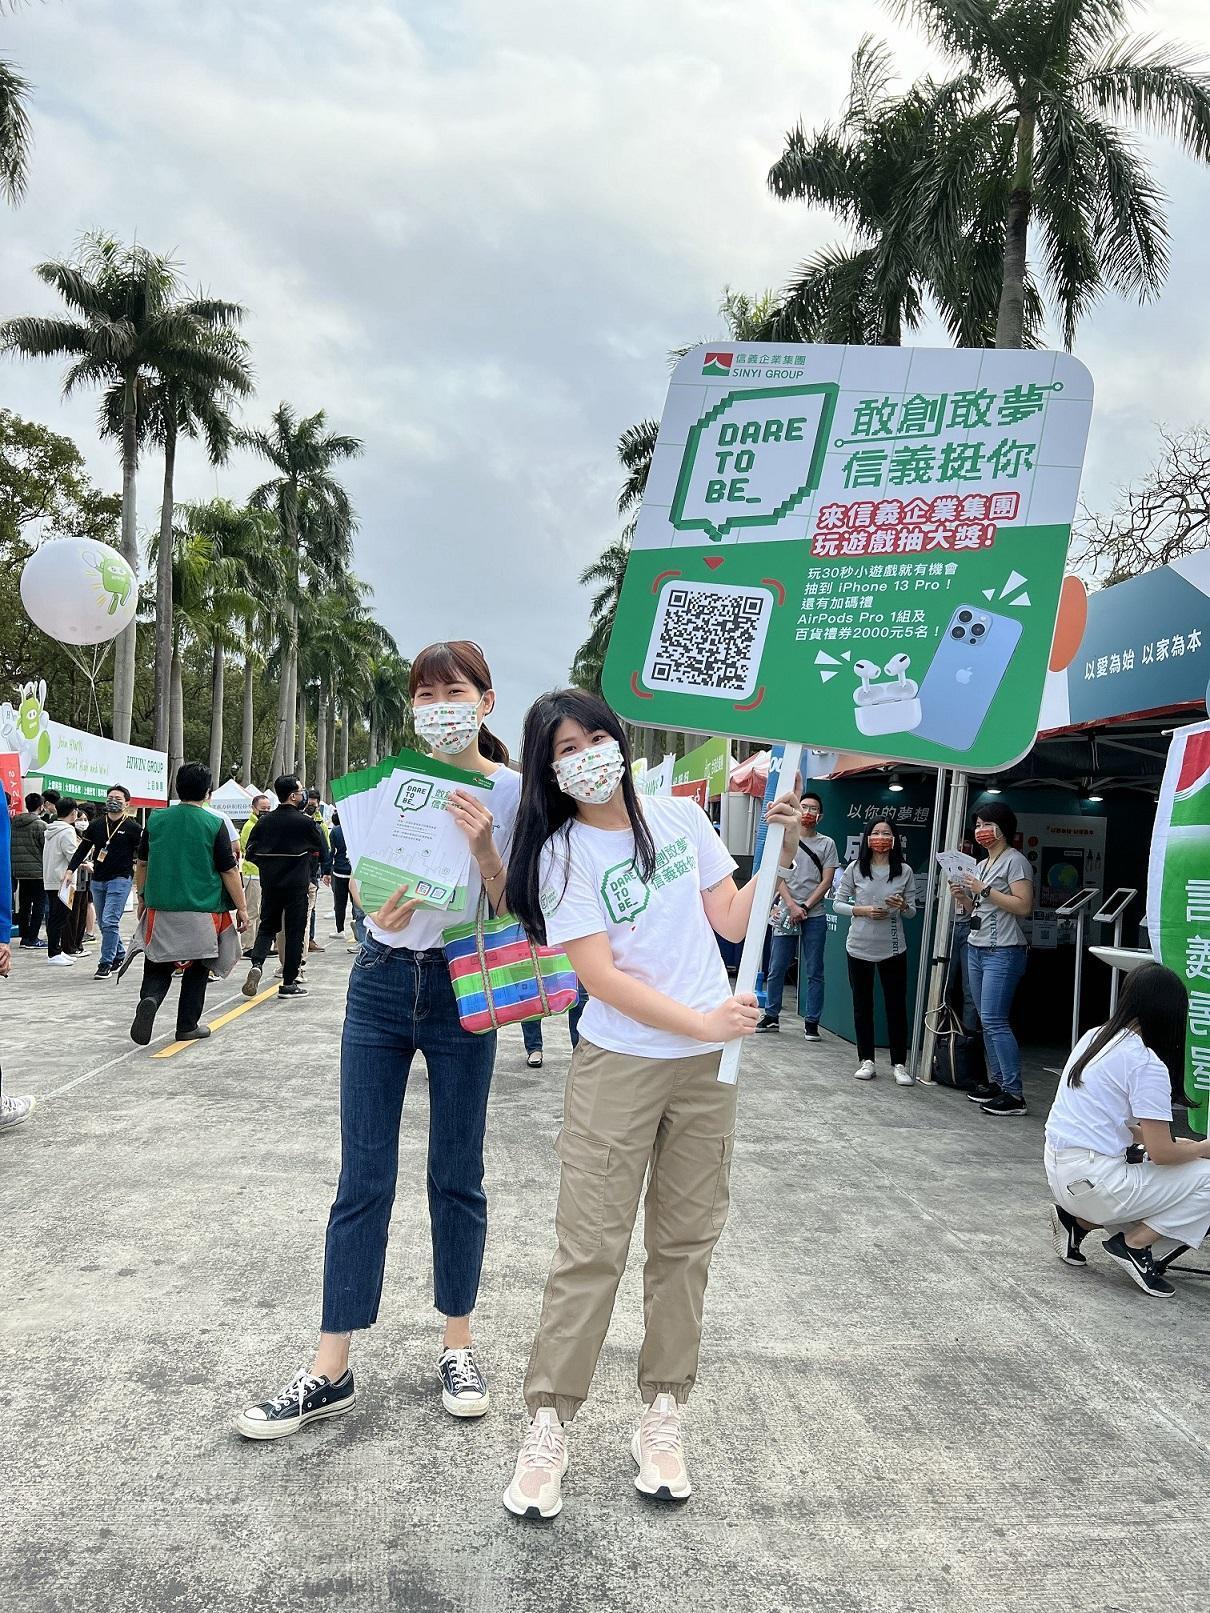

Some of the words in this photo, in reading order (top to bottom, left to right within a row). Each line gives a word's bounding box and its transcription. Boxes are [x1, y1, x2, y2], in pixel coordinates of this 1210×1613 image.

[736, 353, 806, 365] 信義企業集團
[732, 368, 761, 378] SINYI
[765, 369, 804, 379] GROUP
[851, 383, 1044, 436] 敢創敢夢
[718, 417, 807, 446] DARE
[715, 449, 755, 474] TO
[841, 438, 1036, 489] 信義挺你
[817, 492, 1019, 529] 來信義企業集團
[812, 524, 995, 556] 玩遊戲抽大獎!
[807, 562, 958, 579] 玩30秒小遊戲就有機會
[804, 581, 832, 595] 抽到
[838, 582, 887, 593] iPhone
[894, 580, 909, 591] 13
[801, 595, 874, 611] 還有加碼禮
[797, 613, 853, 624] AirPods
[859, 612, 884, 623] Pro
[890, 610, 925, 623] 1組及
[1084, 648, 1135, 680] 以愛為始
[1141, 628, 1202, 665] 以家為本
[147, 760, 163, 774] GROUP
[405, 791, 415, 799] TO
[406, 785, 427, 795] DARE
[848, 804, 930, 822] 以你的夢想
[609, 871, 637, 892] DARE
[614, 887, 629, 902] TO
